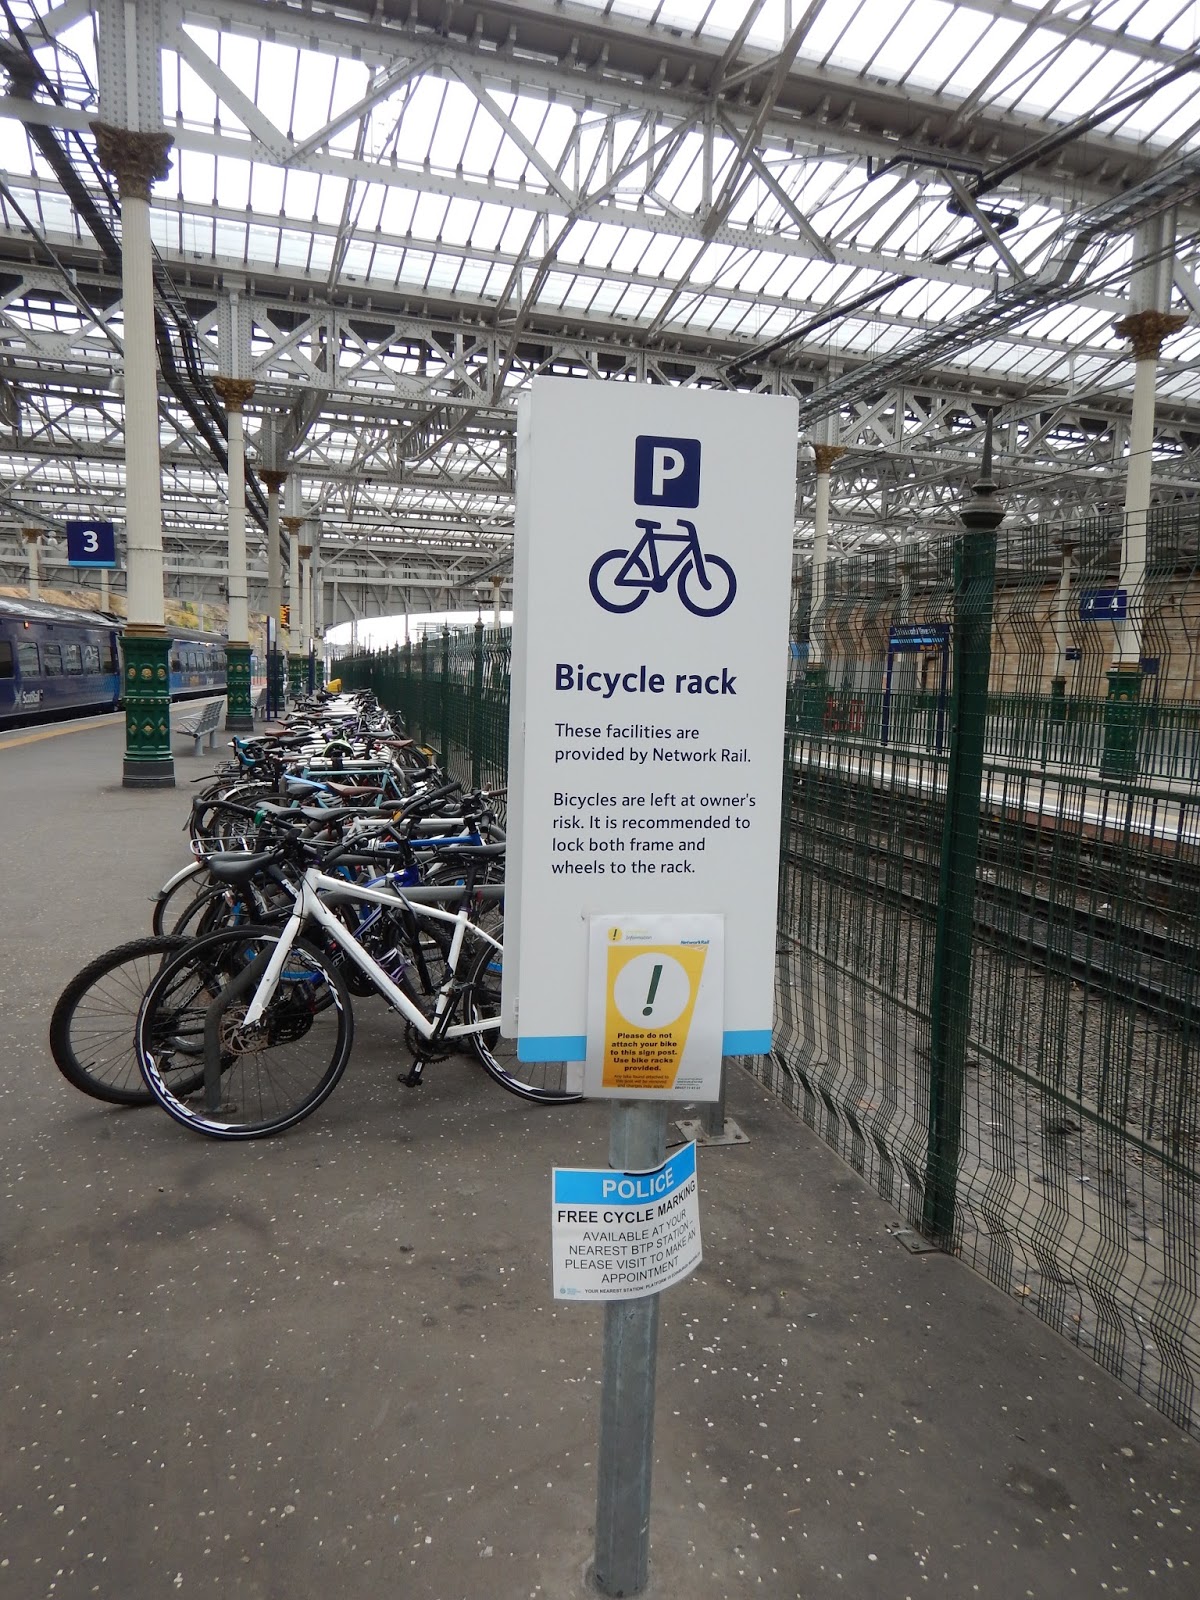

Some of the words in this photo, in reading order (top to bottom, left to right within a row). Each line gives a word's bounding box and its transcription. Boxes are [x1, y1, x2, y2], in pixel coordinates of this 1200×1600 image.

[652, 446, 685, 496] P
[82, 530, 99, 552] 3
[555, 663, 665, 698] Bicycle
[675, 668, 738, 695] rack
[554, 723, 601, 738] These
[606, 724, 672, 739] facilities
[676, 727, 700, 740] are
[554, 746, 624, 764] provided
[630, 747, 648, 764] by
[652, 748, 716, 762] Network
[721, 748, 751, 762] Rail.
[553, 792, 618, 809] Bicycles
[622, 796, 646, 807] are
[650, 793, 676, 807] left
[680, 795, 696, 807] at
[700, 794, 756, 807] owner's
[552, 816, 584, 829] risk.
[589, 816, 600, 829] It
[606, 816, 618, 829] is
[622, 816, 731, 829] recommended
[735, 817, 751, 829] to
[552, 838, 584, 852] lock
[589, 838, 625, 852] both
[630, 838, 674, 851] frame
[678, 837, 706, 851] and
[552, 860, 605, 874] wheels
[610, 862, 626, 874] to
[631, 860, 656, 874] the
[660, 860, 696, 874] rack.
[602, 1167, 674, 1198] POLICE
[558, 1210, 598, 1223] FREE
[603, 1209, 654, 1223] CYCLE
[657, 1180, 696, 1217] MARKING
[582, 1229, 649, 1242] AVAILABLE
[652, 1224, 664, 1237] AT
[666, 1208, 687, 1229] YOUR
[565, 1259, 613, 1269] PLEASE
[616, 1256, 647, 1269] VISIT
[650, 1251, 664, 1264] TO
[665, 1237, 688, 1257] MAKE
[686, 1228, 696, 1244] AN
[569, 1245, 628, 1256] NEAREST
[631, 1242, 654, 1255] BTP
[656, 1222, 689, 1248] STATION
[601, 1256, 679, 1283] APPOINTMENT
